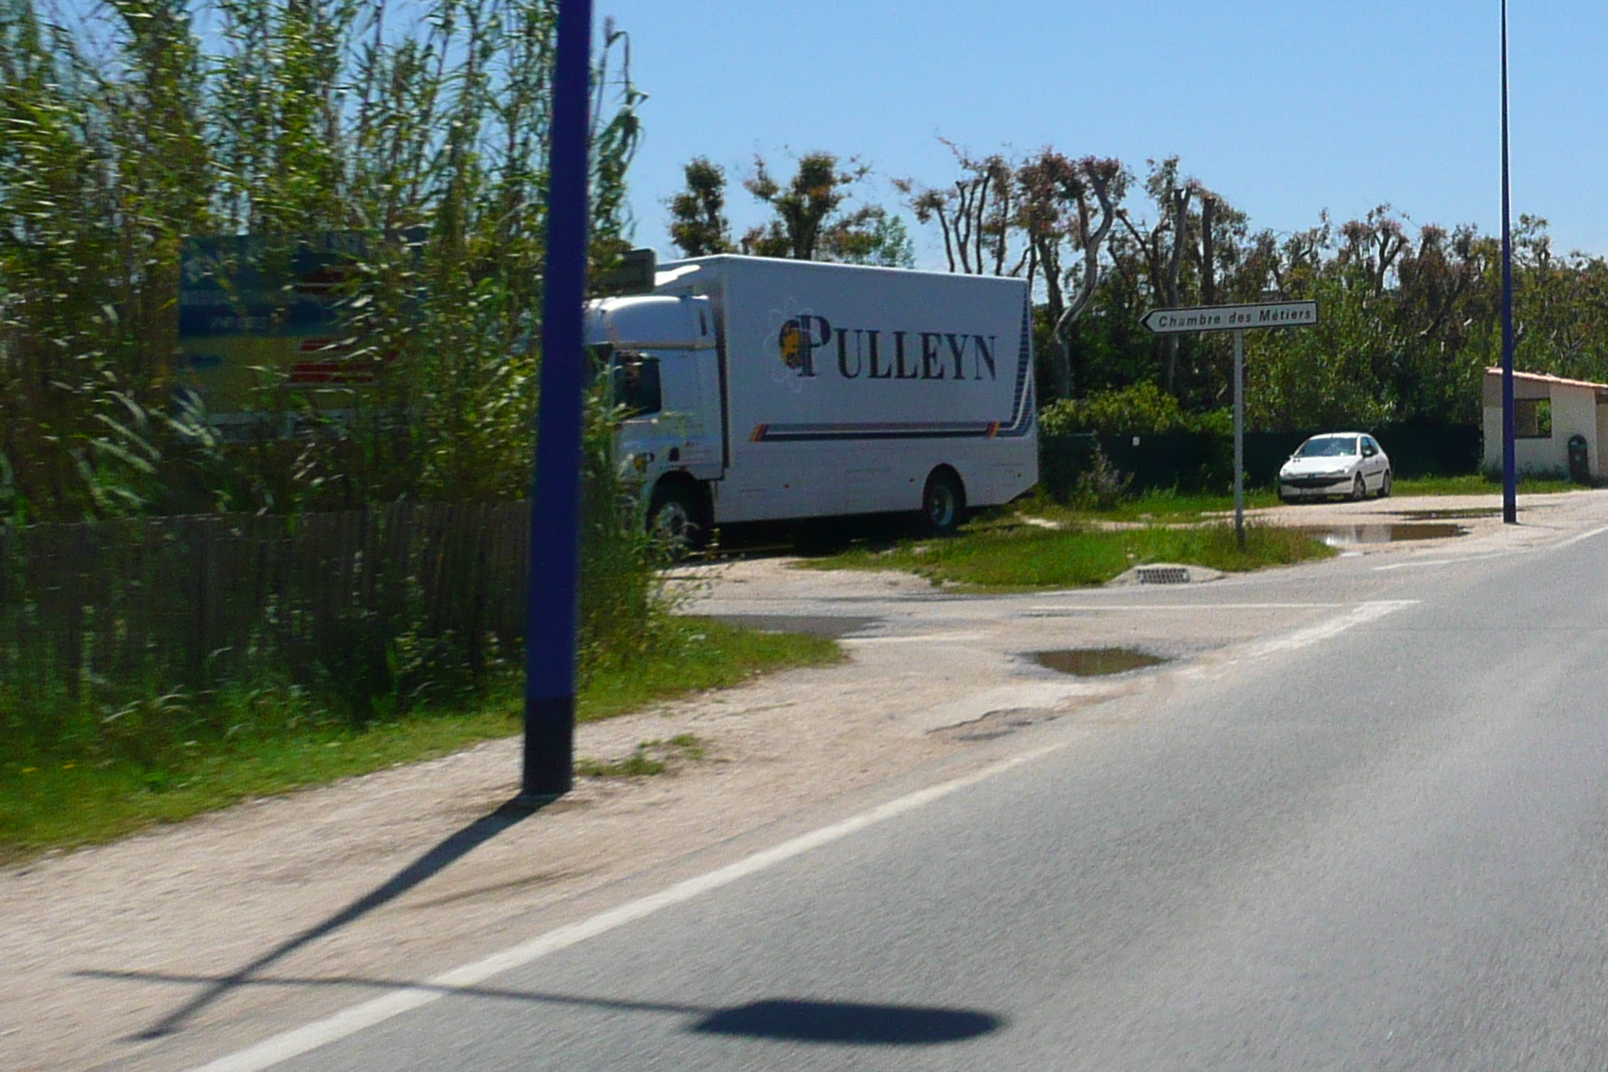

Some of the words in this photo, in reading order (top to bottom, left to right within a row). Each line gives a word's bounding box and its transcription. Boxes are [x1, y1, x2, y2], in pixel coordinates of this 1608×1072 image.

[1158, 313, 1221, 328] Chambre
[1228, 311, 1251, 324] des
[1258, 308, 1311, 322] Métiers
[796, 314, 997, 381] PULLEYN
